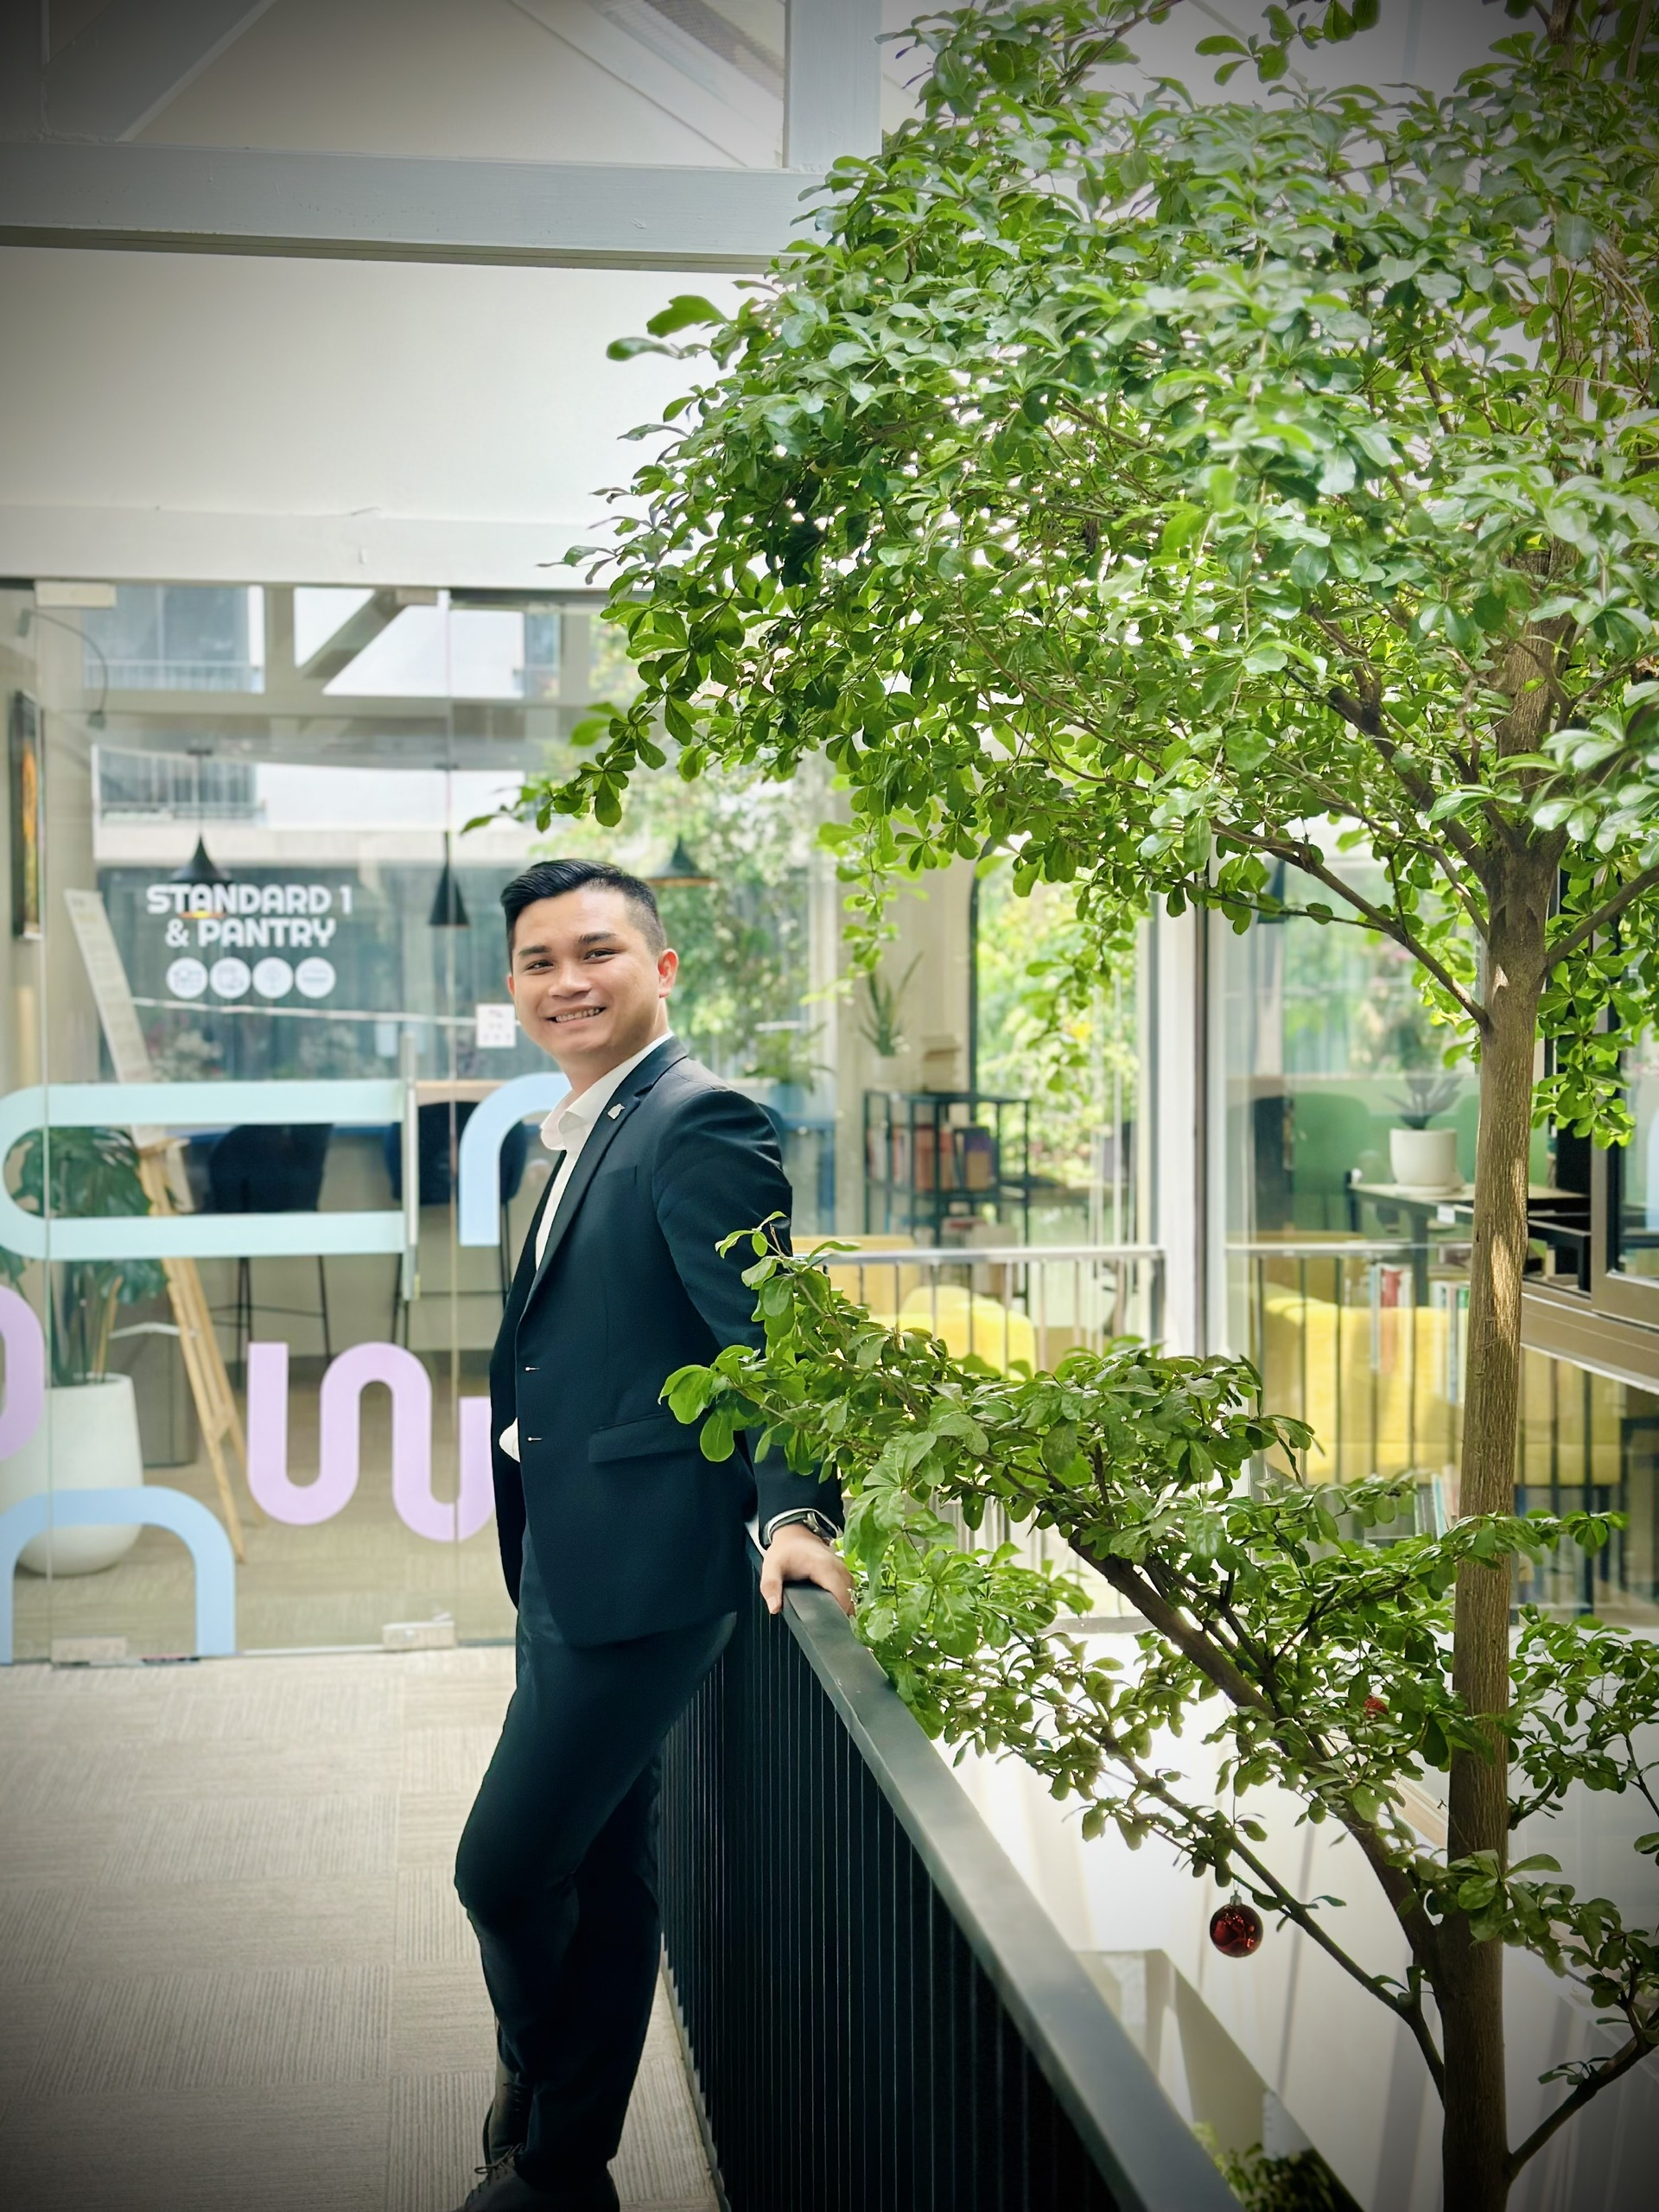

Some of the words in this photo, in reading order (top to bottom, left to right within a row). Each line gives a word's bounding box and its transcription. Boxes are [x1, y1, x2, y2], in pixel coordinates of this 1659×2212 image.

[146, 884, 333, 914] STANDARD
[340, 885, 353, 914] 1
[165, 918, 189, 947] &
[198, 918, 336, 948] PANTRY
